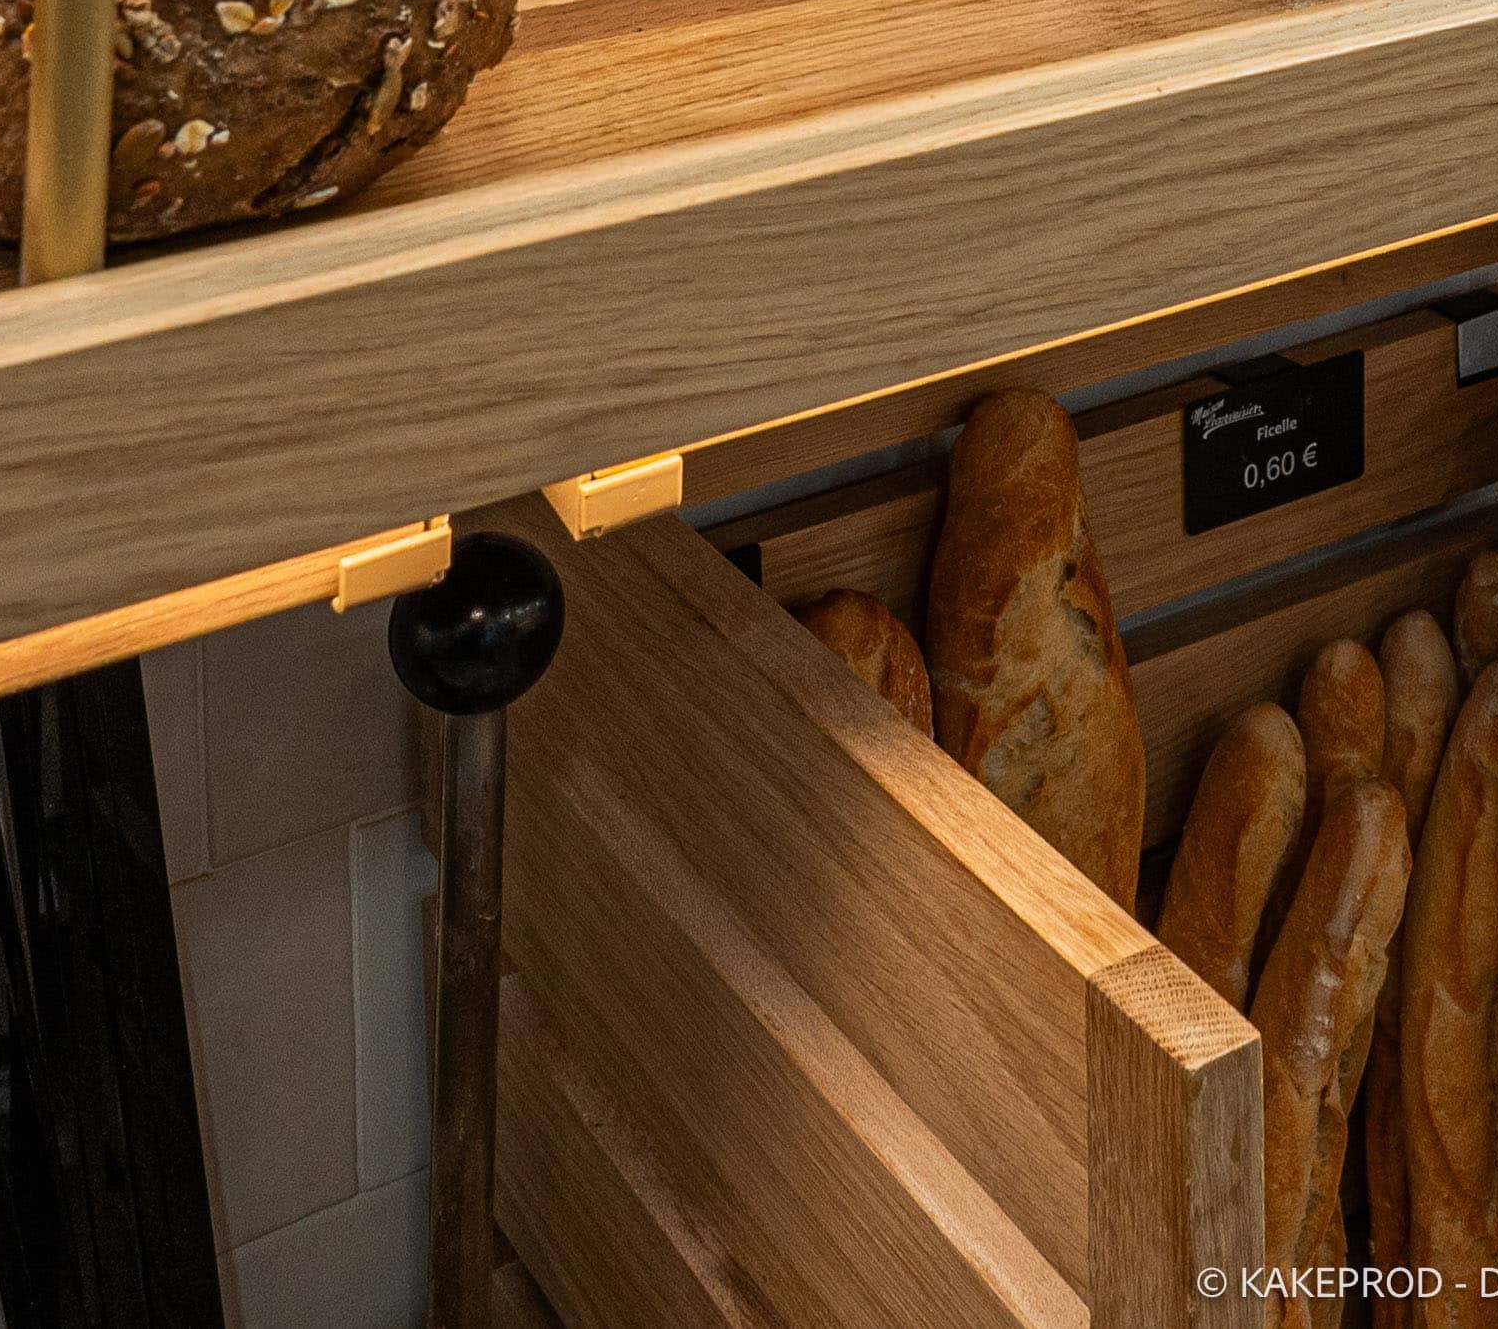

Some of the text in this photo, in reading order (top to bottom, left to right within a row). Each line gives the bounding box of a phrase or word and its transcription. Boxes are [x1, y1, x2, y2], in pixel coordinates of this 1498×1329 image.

[1257, 417, 1298, 441] Ficelle
[1244, 442, 1318, 489] 0,60 €
